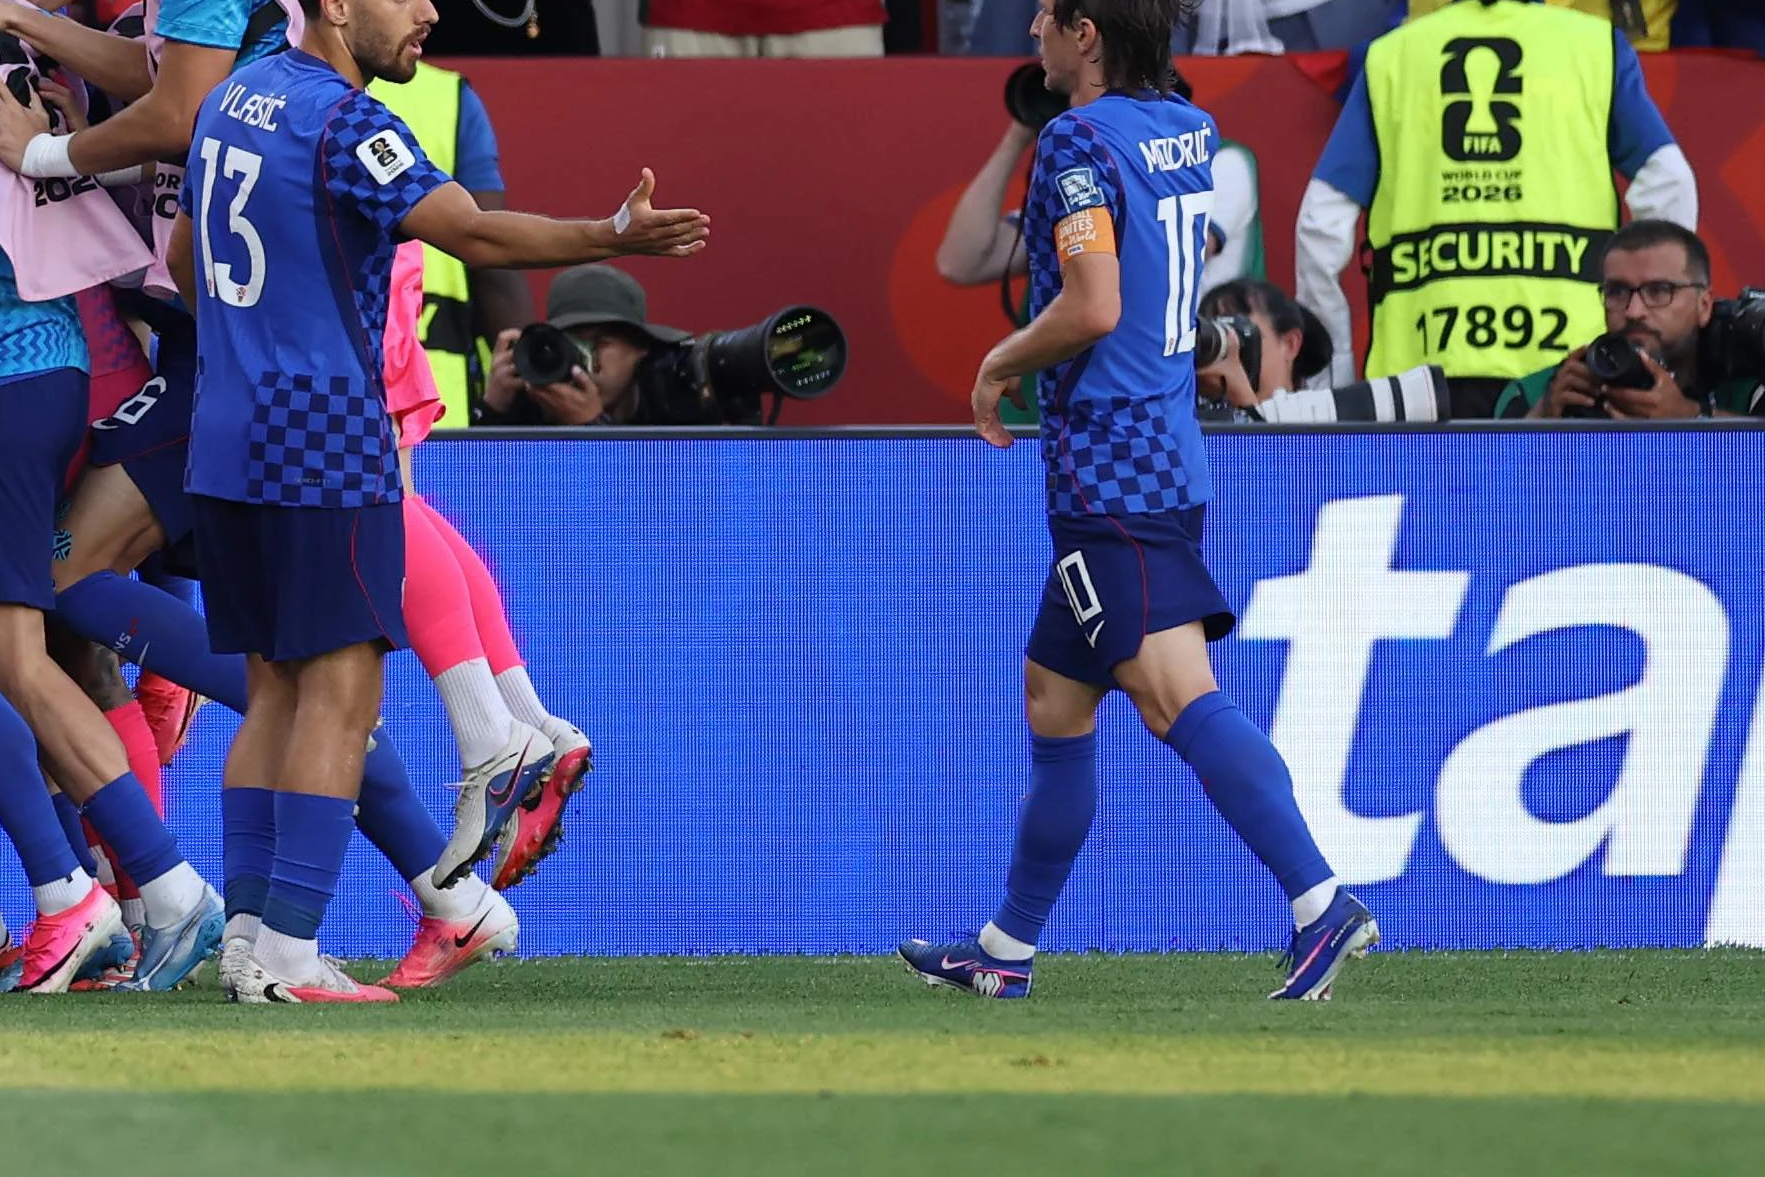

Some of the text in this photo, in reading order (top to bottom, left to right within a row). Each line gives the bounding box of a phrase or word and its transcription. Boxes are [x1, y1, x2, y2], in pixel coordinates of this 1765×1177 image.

[1463, 135, 1502, 154] FIFA
[34, 174, 98, 208] 202
[1441, 184, 1523, 204] 2026
[200, 136, 266, 308] 13
[1157, 190, 1214, 357] 10
[1391, 230, 1589, 284] SECURITY
[1416, 304, 1570, 357] 17892
